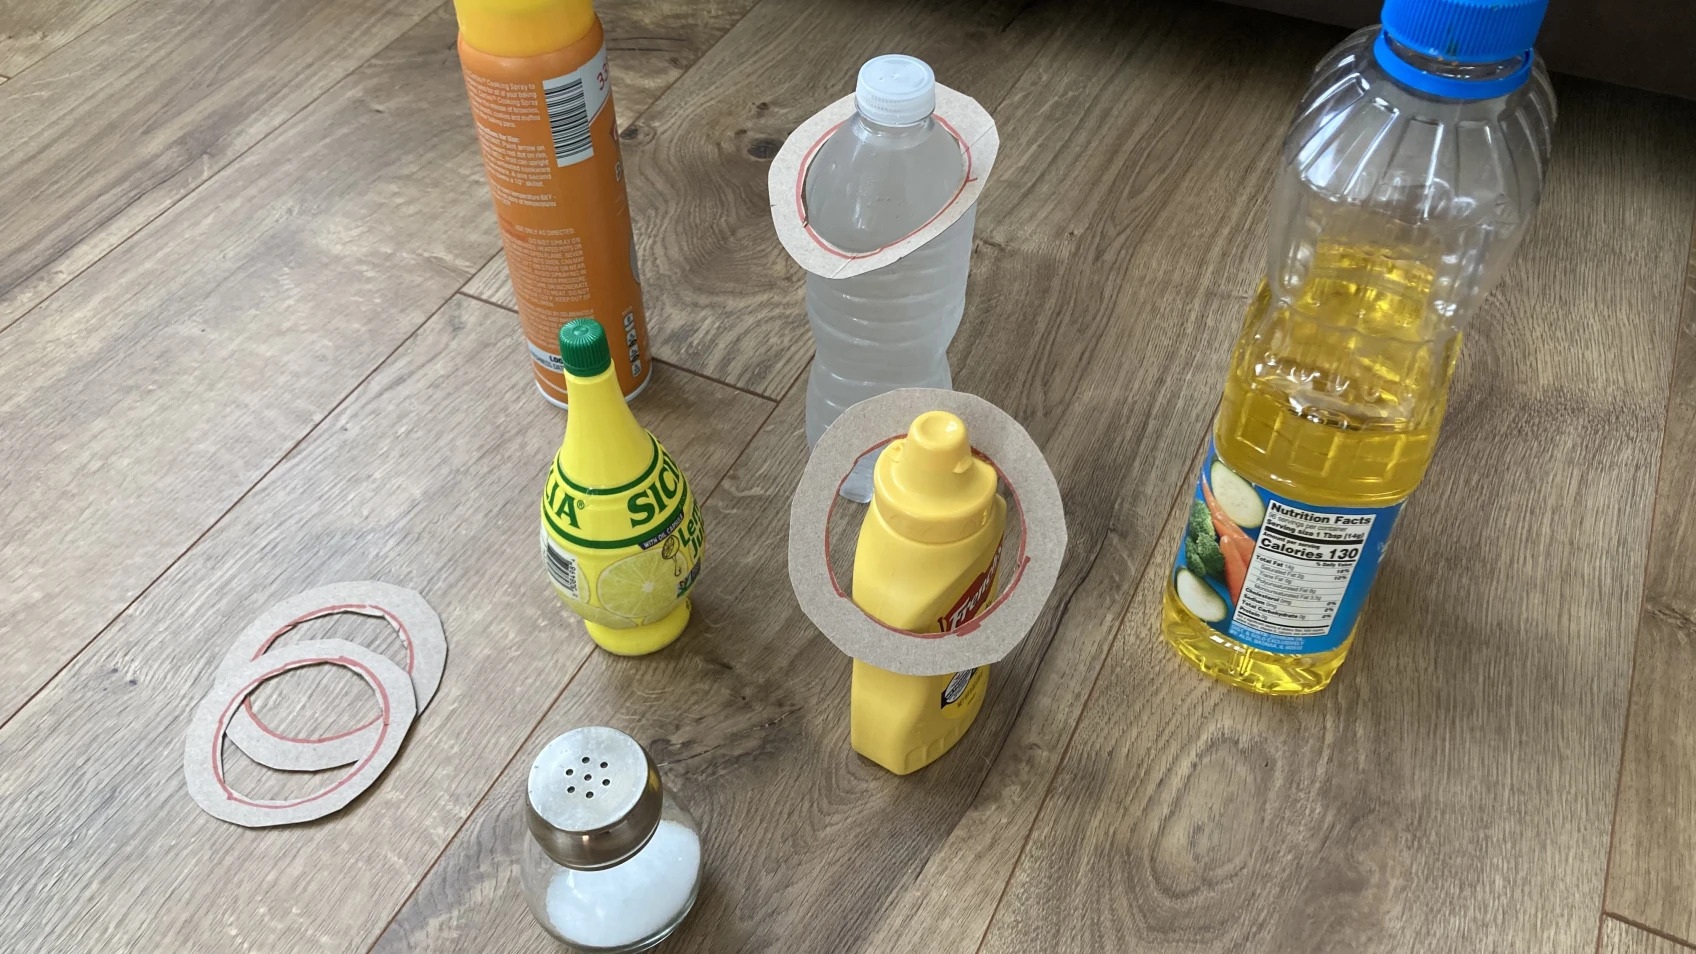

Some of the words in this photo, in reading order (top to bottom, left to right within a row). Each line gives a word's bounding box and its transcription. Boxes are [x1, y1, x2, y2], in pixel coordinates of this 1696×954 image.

[1271, 502, 1330, 524] Nutrition
[1334, 516, 1372, 525] Facts
[1266, 519, 1296, 534] Serving
[1298, 528, 1314, 537] size
[1278, 514, 1305, 529] servings
[1306, 523, 1317, 532] per
[1262, 532, 1286, 542] Amount
[1261, 538, 1324, 559] Calories
[1329, 548, 1359, 560] 130
[1256, 554, 1272, 564] Total
[1273, 560, 1283, 568] Fat
[1261, 564, 1284, 576] Saturated
[1244, 594, 1265, 606] Sodium
[1246, 587, 1280, 602] Cholesterol
[1240, 606, 1260, 618] Protein
[1242, 600, 1256, 610] Total
[1258, 606, 1298, 619] Carbohydrate
